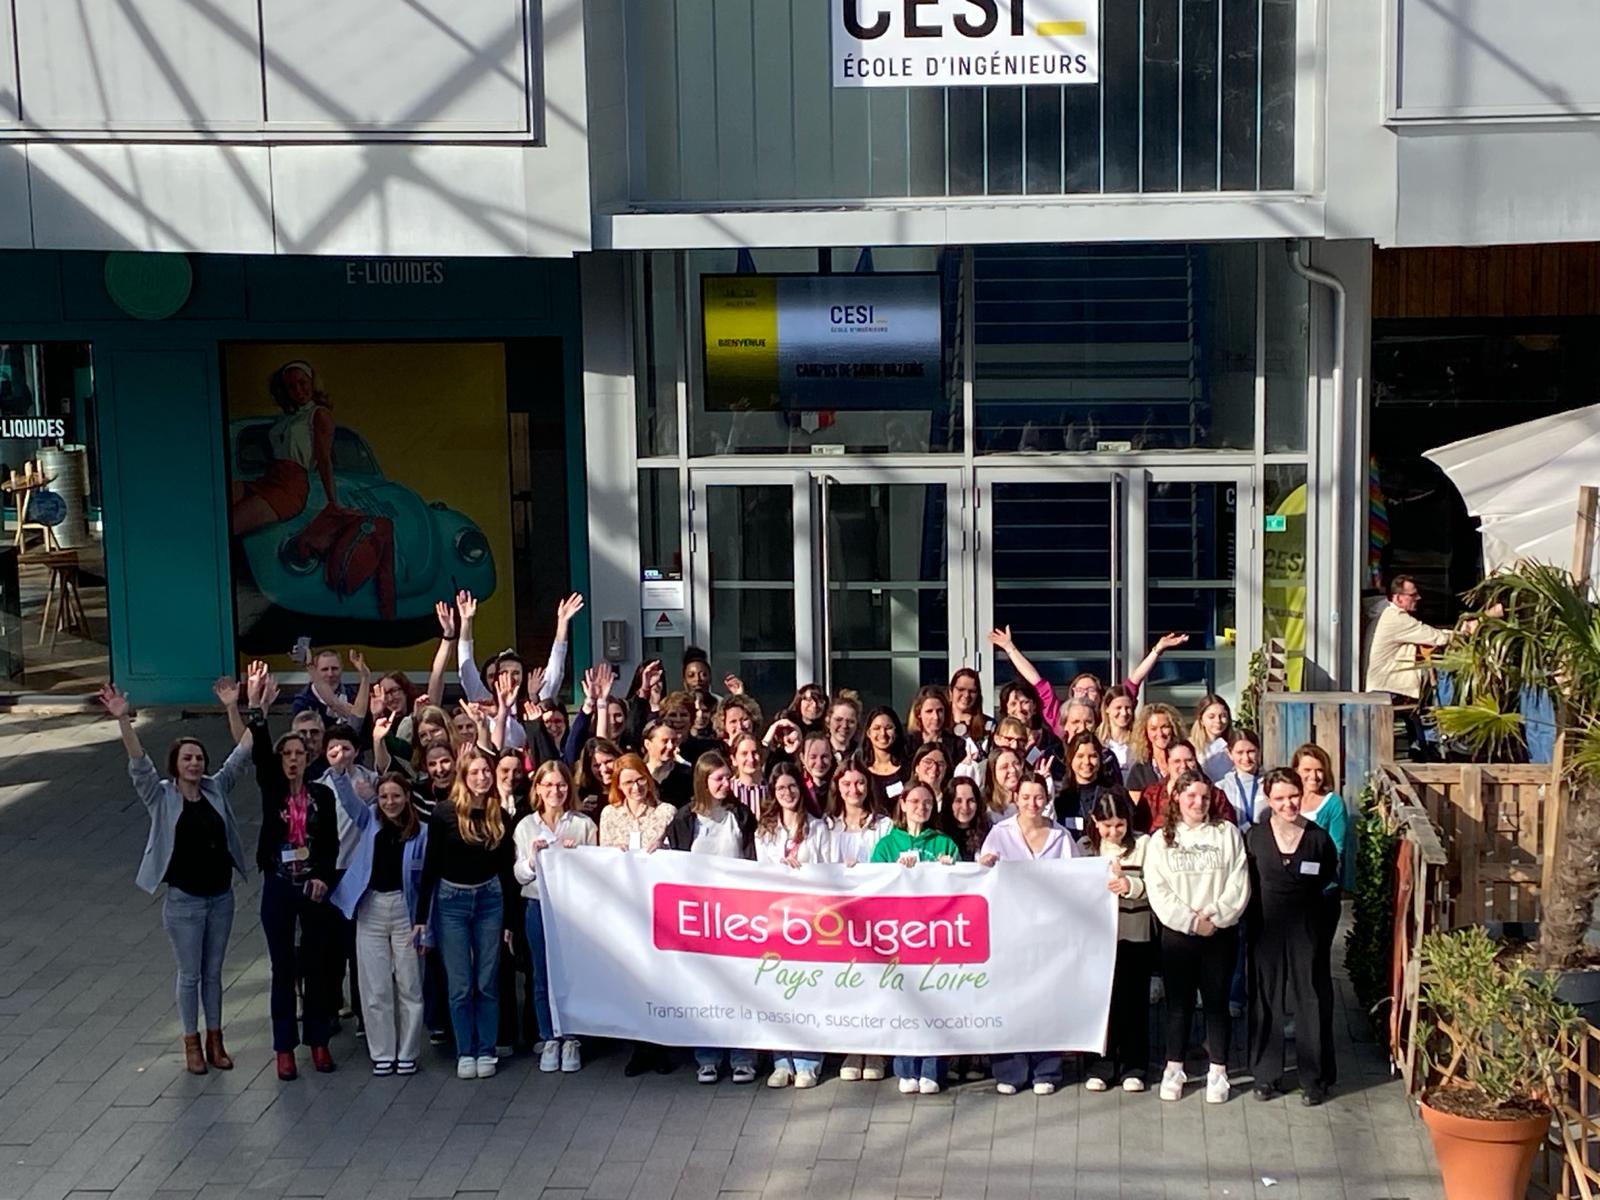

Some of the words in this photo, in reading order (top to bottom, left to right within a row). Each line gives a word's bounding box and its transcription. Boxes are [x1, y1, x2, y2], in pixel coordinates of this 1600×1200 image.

[843, 53, 912, 78] ÉCOLE
[926, 51, 1087, 76] D'INGÉNIEURS
[345, 261, 444, 284] E-LIQUIDES
[830, 305, 874, 325] CESI
[718, 338, 766, 348] BIENVENUE
[796, 363, 838, 378] CAMPUS
[839, 363, 852, 378] DE
[678, 900, 769, 943] Elles
[782, 906, 972, 956] bougent
[754, 952, 824, 1000] Pays
[834, 957, 865, 989] de
[879, 956, 905, 992] la
[919, 957, 991, 992] Loire
[645, 1002, 736, 1020] Transmettre
[740, 1004, 753, 1020] la
[757, 1008, 821, 1028] passion,
[825, 1011, 885, 1029] susciter
[889, 1014, 920, 1029] des
[924, 1013, 1003, 1030] vocations
